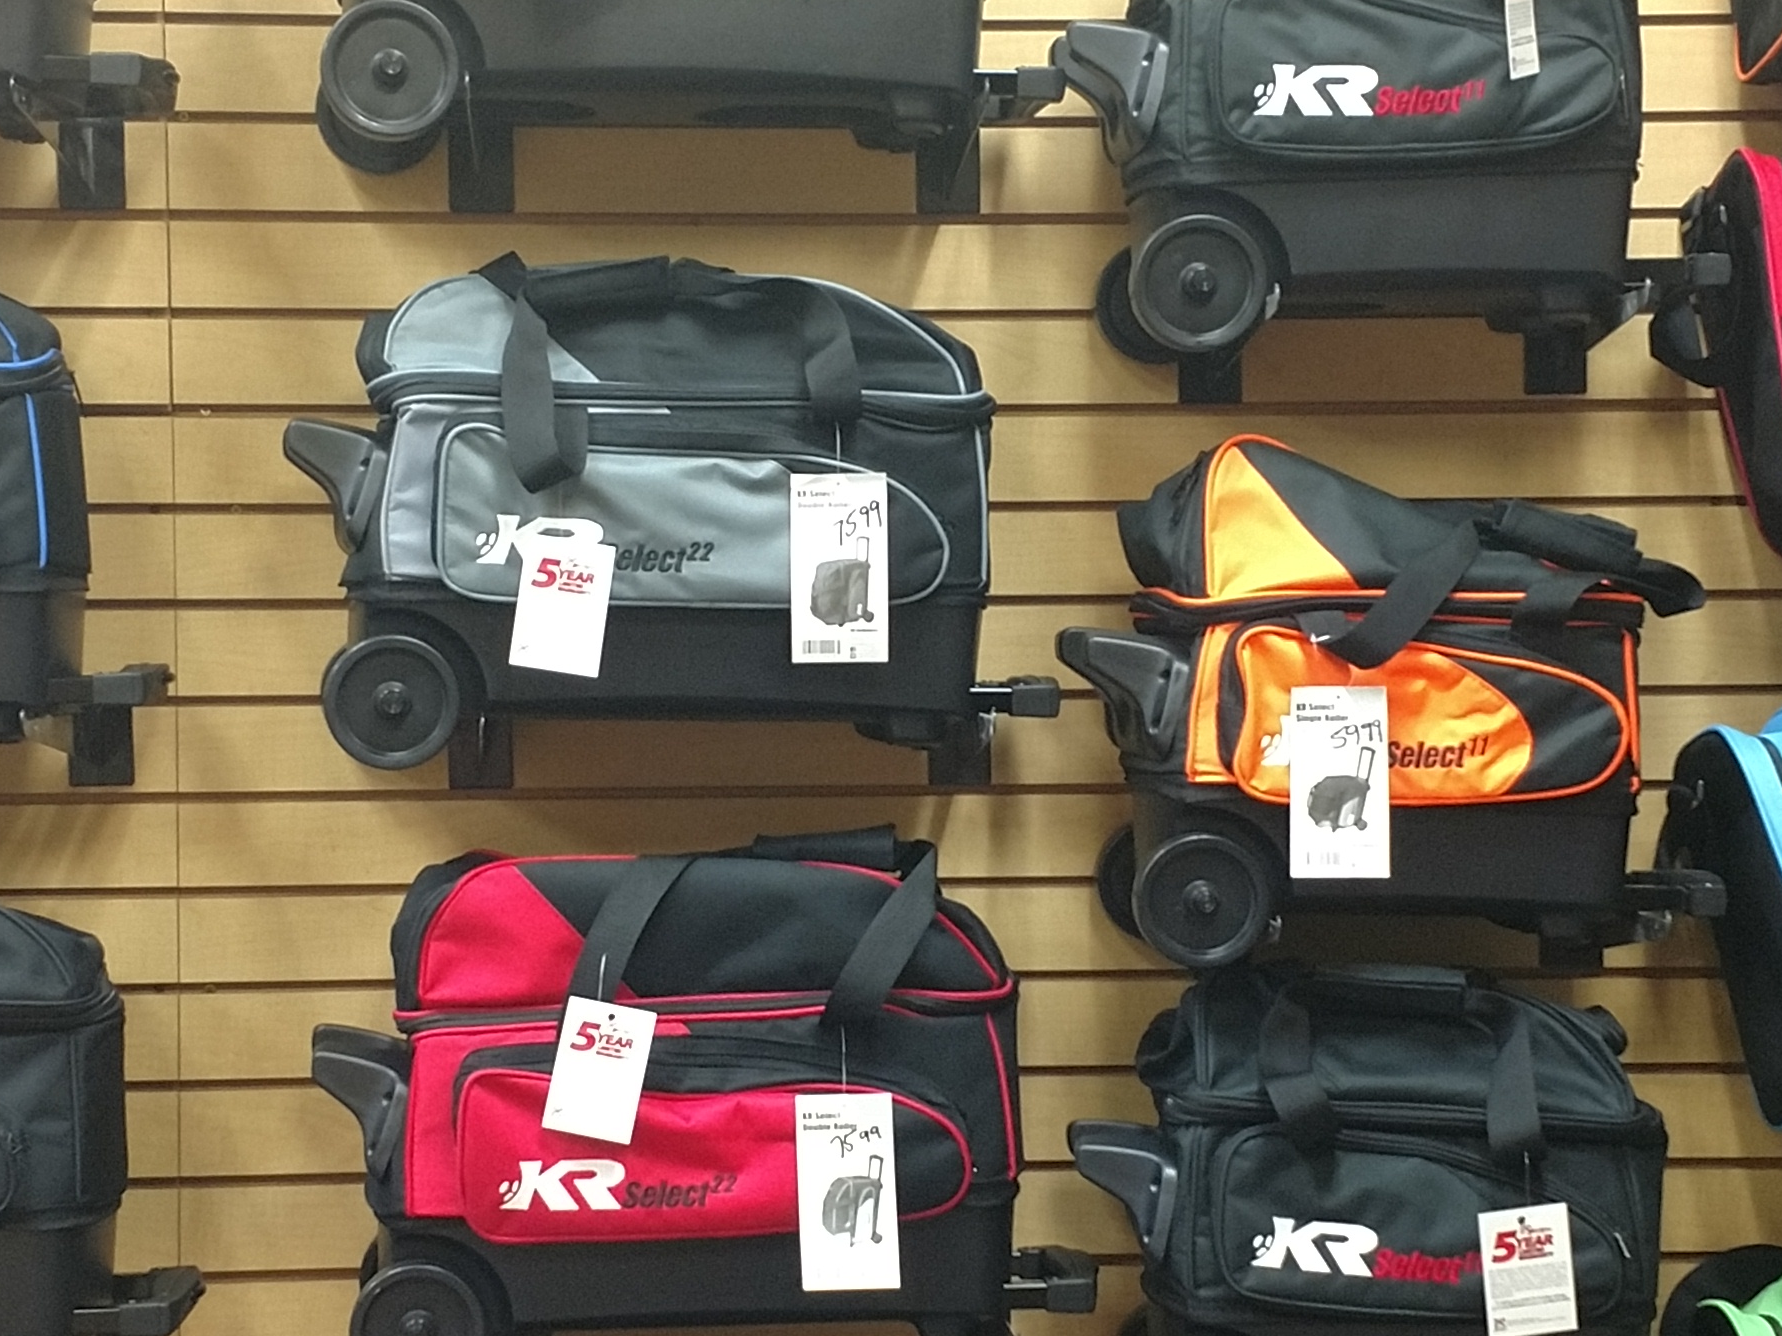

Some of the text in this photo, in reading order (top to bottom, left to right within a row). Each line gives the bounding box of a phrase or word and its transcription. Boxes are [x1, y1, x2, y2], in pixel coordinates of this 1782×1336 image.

[1253, 64, 1379, 116] KR
[531, 558, 595, 587] 5 YEAR
[570, 1021, 633, 1051] 5 YEAR
[500, 1159, 626, 1211] KR
[1251, 1216, 1379, 1278] KR
[1492, 1230, 1518, 1263] 5
[1516, 1233, 1555, 1248] YEAR
